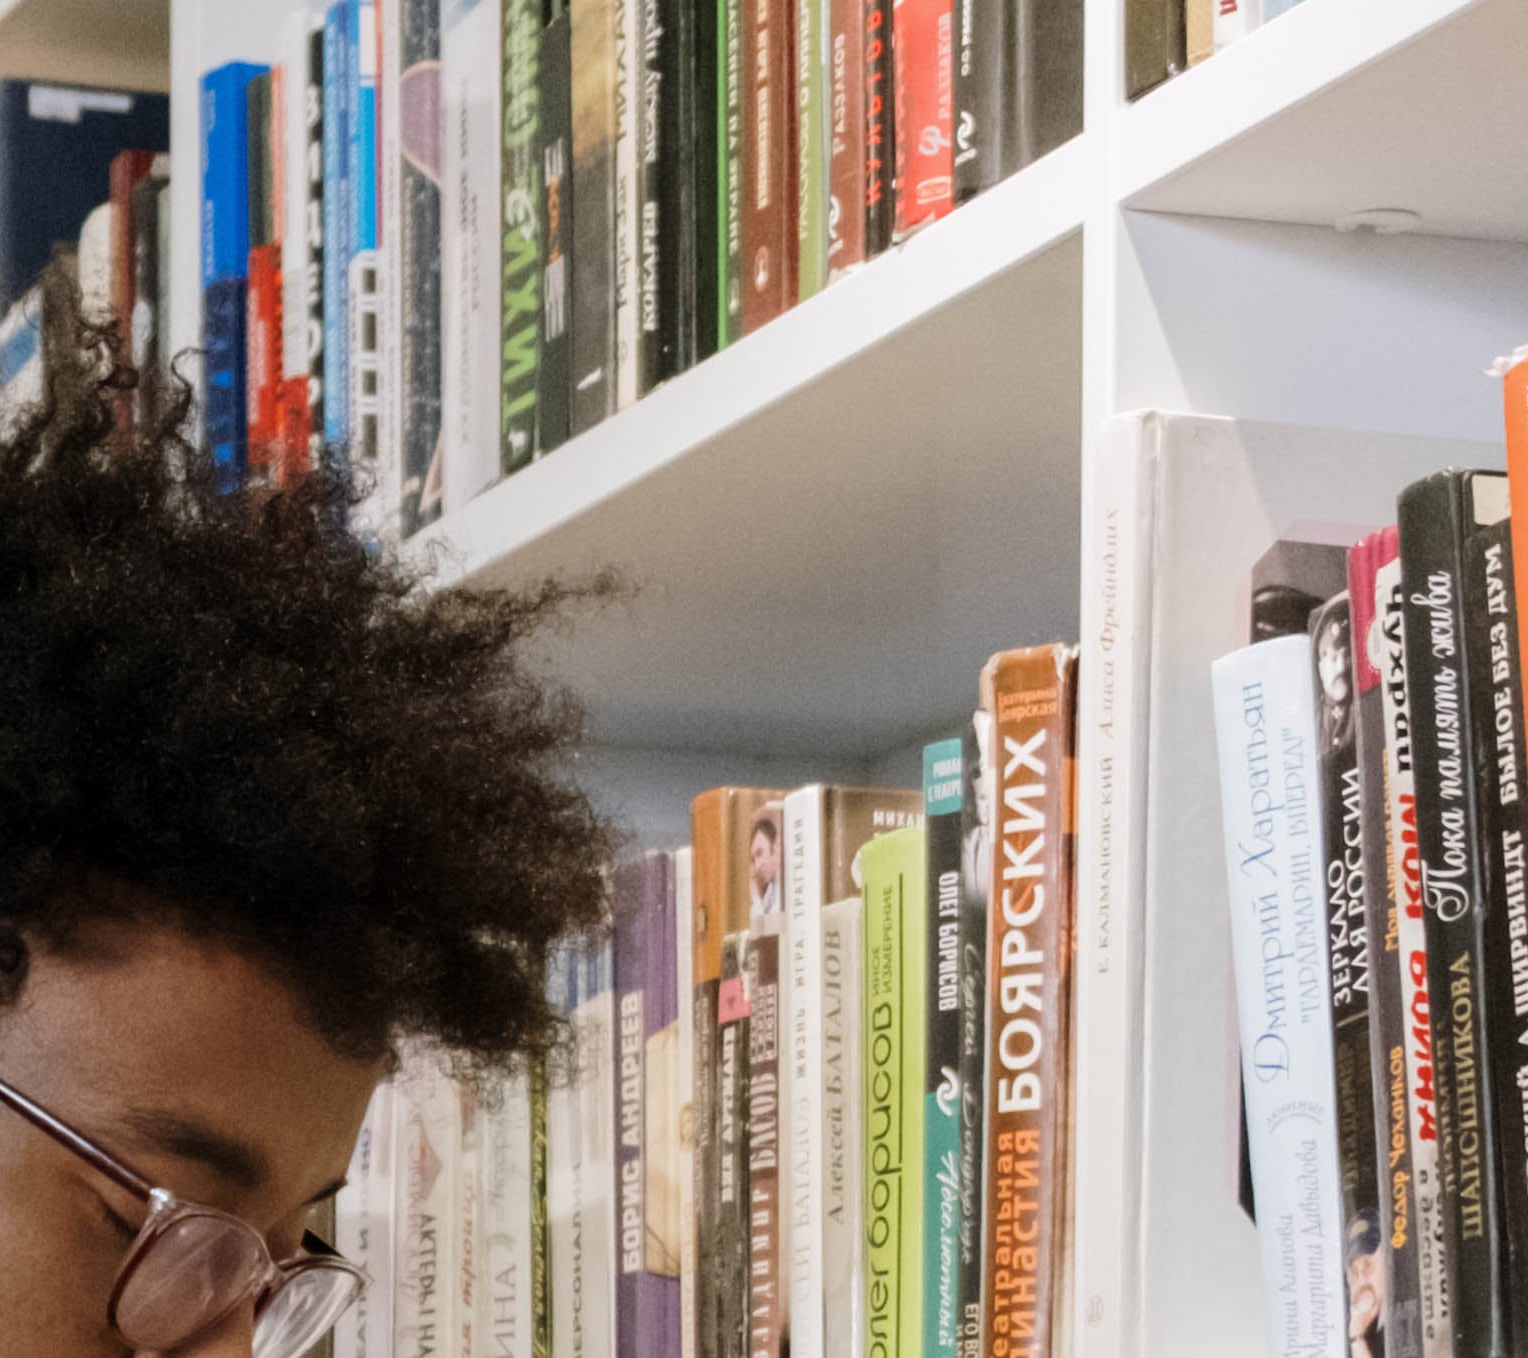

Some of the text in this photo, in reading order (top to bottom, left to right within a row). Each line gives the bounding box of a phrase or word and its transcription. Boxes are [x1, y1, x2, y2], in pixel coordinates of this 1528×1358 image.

[1412, 572, 1469, 921] Пока память жива
[1483, 545, 1517, 802] БЫЛОЕ БЕЗ ДУМ
[938, 871, 961, 1011] ОЛЕГ БОРИСОВ
[999, 728, 1046, 1113] БОЯРСКИХ
[1096, 757, 1115, 949] КАЛМАНОВСКИЙ
[1238, 681, 1291, 1084] Дмитрий Харатьян
[1327, 860, 1352, 1006] ЗЕРКАЛО
[1339, 768, 1365, 916] РОССИИ
[621, 990, 645, 1273] БОРИС АНДРЕЕВ
[747, 1074, 777, 1169] БАСОВ
[823, 929, 846, 1226] Алексей БАТАЛОВ
[864, 1003, 902, 1248] борисов
